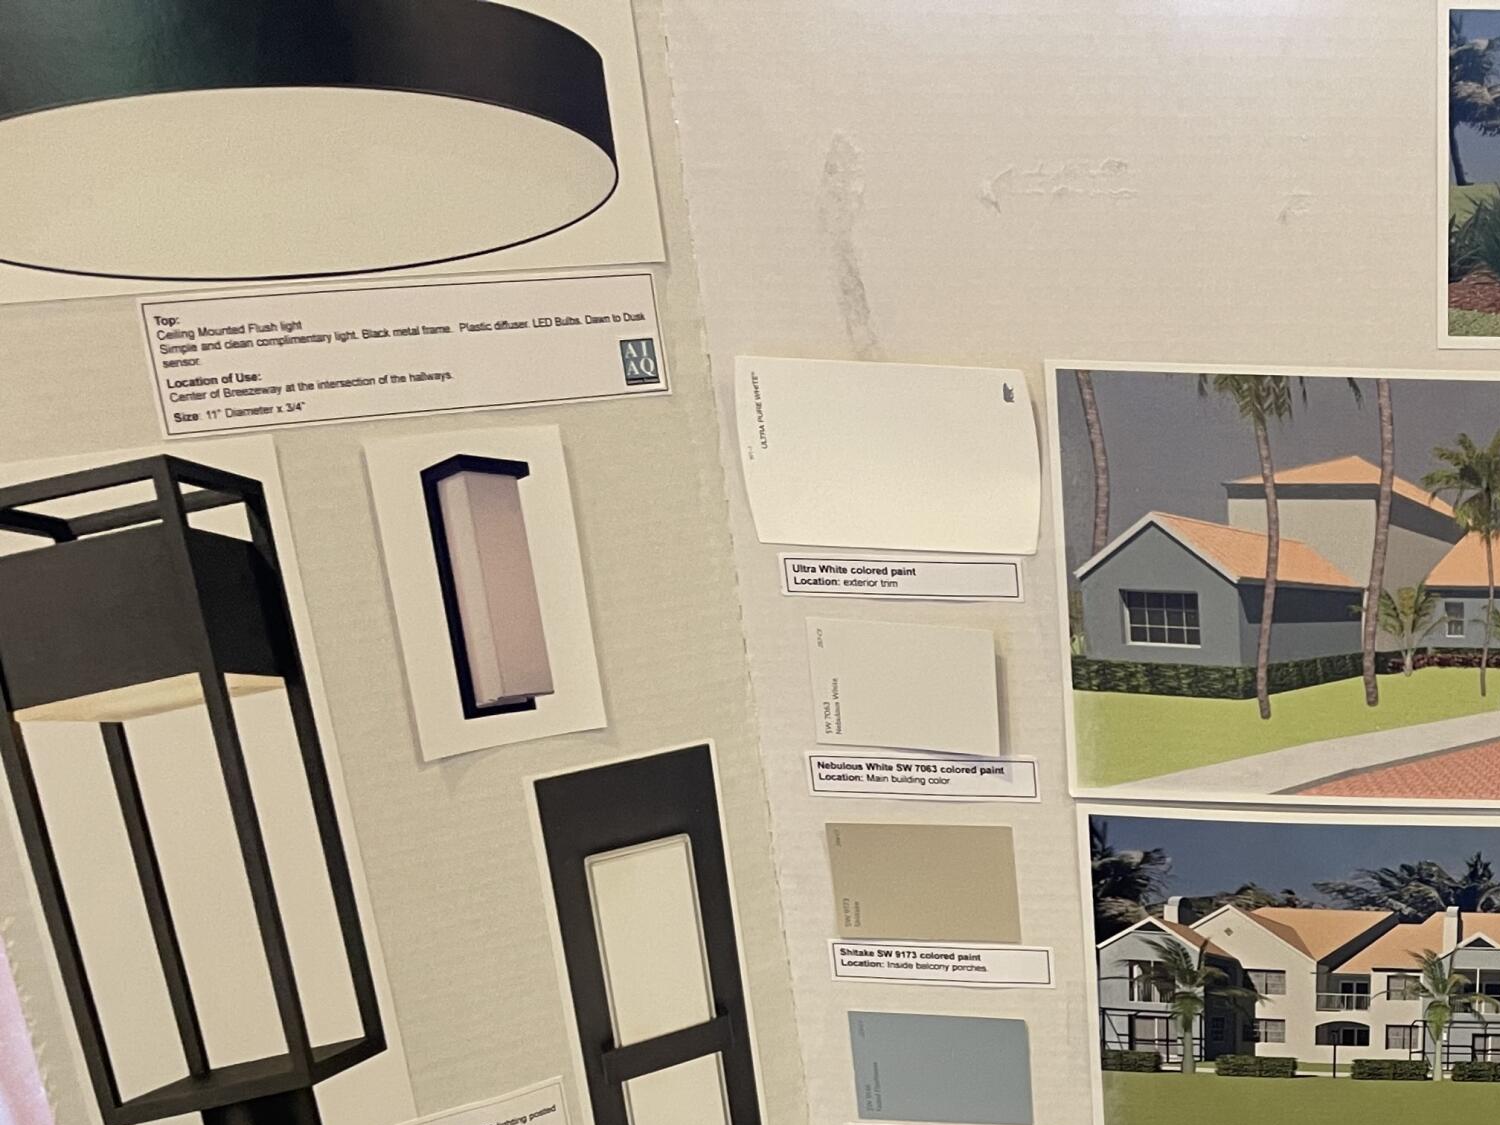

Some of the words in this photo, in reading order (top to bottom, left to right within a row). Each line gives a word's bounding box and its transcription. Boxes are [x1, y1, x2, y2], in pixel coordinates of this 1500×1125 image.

[153, 316, 180, 327] Top:
[156, 330, 195, 341] Ceiling
[197, 325, 246, 337] Mounted
[248, 322, 278, 333] Flush
[280, 320, 302, 333] light
[166, 377, 219, 389] Location
[221, 373, 233, 384] of
[235, 373, 262, 383] Use:
[792, 564, 817, 573] Ultra
[818, 565, 848, 574] White
[850, 566, 888, 575] colored
[891, 567, 916, 577] paint
[793, 576, 840, 586] Location:
[843, 579, 878, 587] exterior
[880, 579, 898, 587] trim
[817, 761, 863, 770] Nebulous
[865, 763, 893, 771] White
[896, 763, 913, 772] SW
[915, 764, 938, 773] 7063
[940, 765, 977, 774] colored
[979, 766, 1005, 776] paint
[818, 772, 863, 782] Location:
[866, 774, 889, 782] Main
[891, 775, 926, 786] building
[928, 777, 951, 785] color
[839, 948, 875, 957] Shitake
[877, 949, 893, 958] SW
[895, 950, 917, 959] 9173
[919, 952, 955, 960] colored
[957, 954, 981, 962] paint
[841, 959, 884, 968] Location:
[887, 961, 914, 969] Inside
[915, 962, 950, 972] balcony
